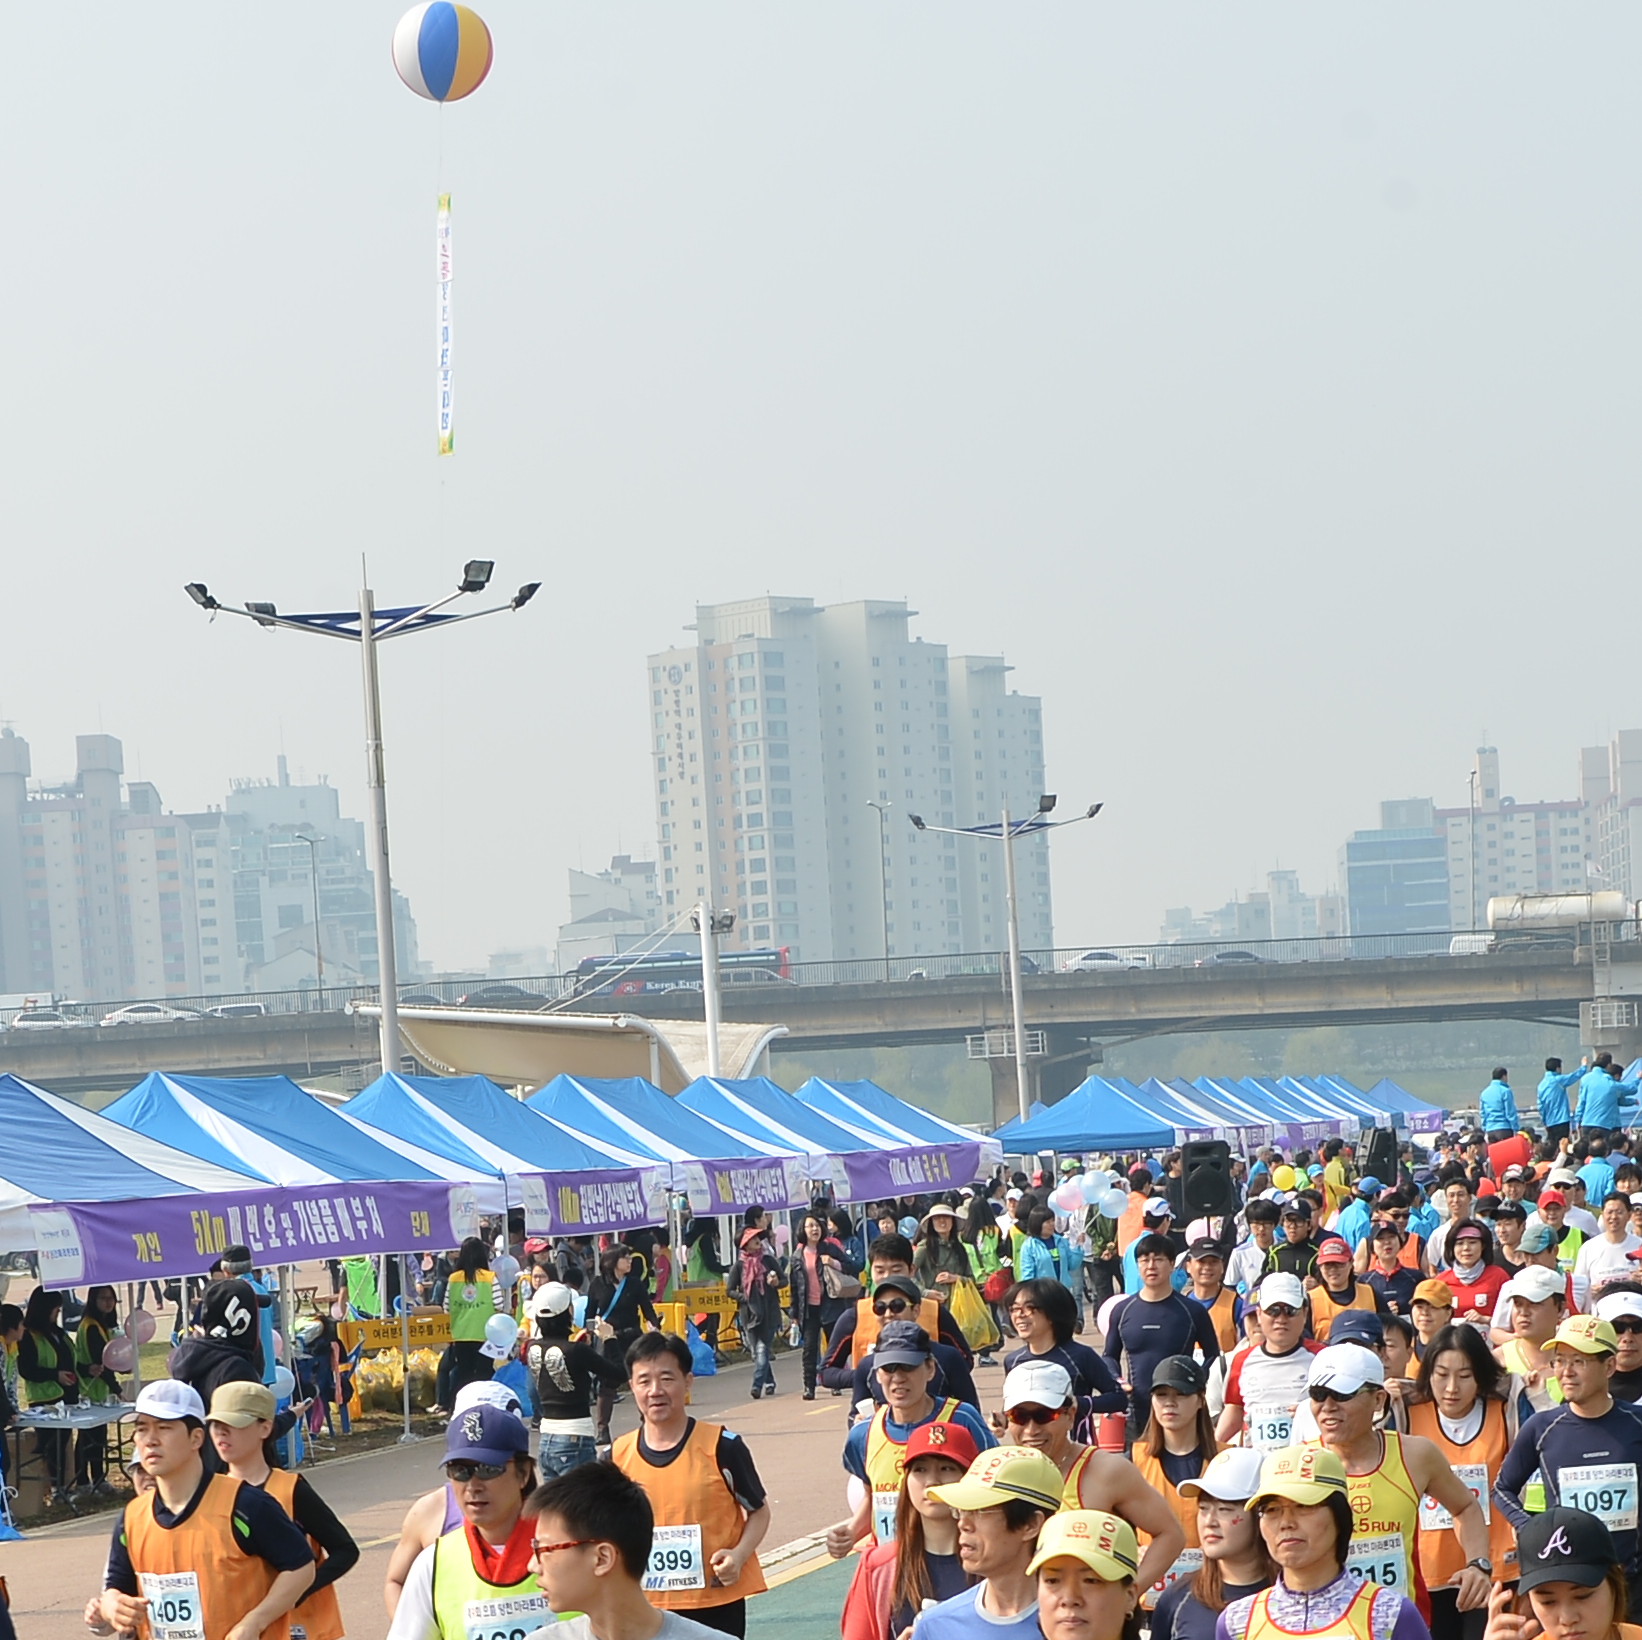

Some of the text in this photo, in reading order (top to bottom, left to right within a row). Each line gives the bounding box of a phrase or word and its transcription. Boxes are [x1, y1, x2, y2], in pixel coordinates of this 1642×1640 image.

[132, 1232, 163, 1263] 개인
[223, 1295, 251, 1336] 5
[928, 1425, 946, 1446] B
[1257, 1421, 1293, 1441] 135
[1568, 1488, 1629, 1512] 1097
[1371, 1520, 1401, 1533] RUN
[1537, 1525, 1572, 1560] A
[668, 1576, 698, 1587] FITNESS
[149, 1598, 192, 1623] 1405
[167, 1628, 198, 1640] FITNESS
